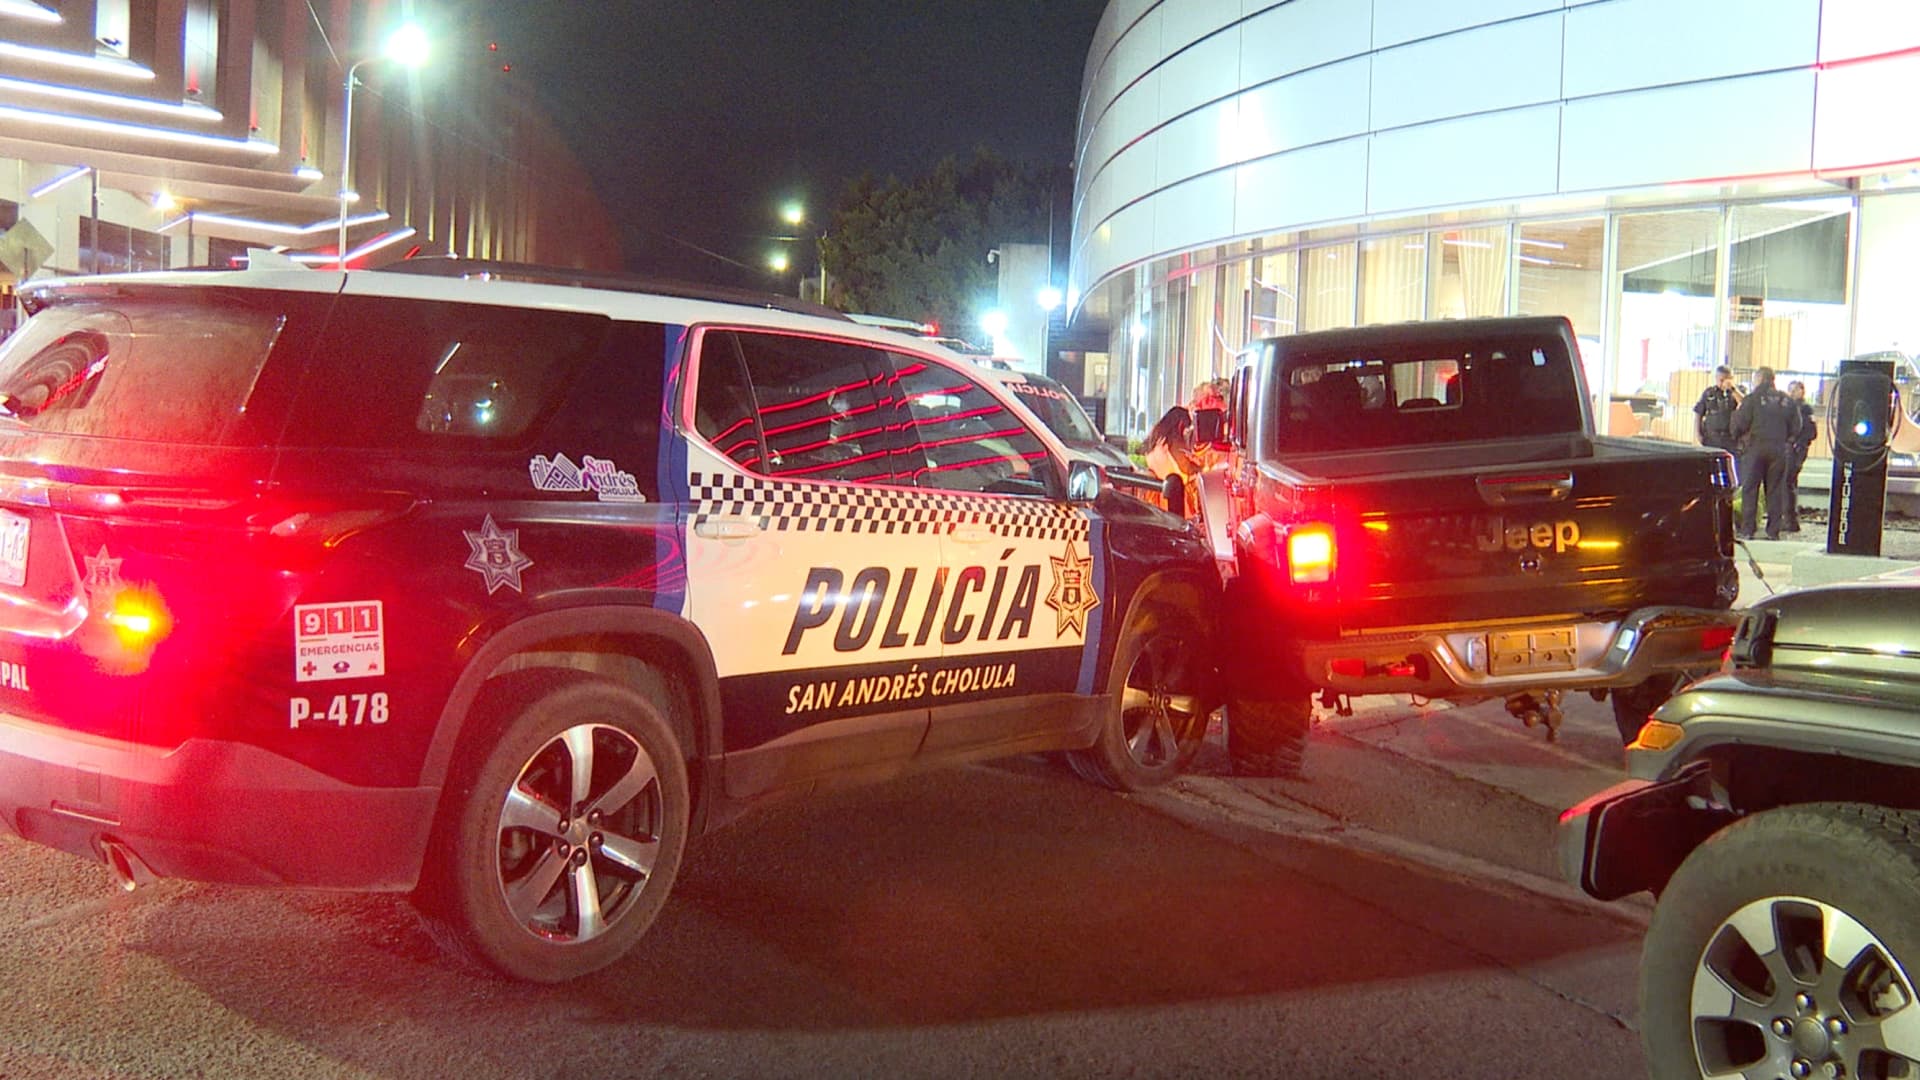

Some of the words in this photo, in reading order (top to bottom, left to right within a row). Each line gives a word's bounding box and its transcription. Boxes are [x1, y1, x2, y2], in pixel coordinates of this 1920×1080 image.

[581, 470, 637, 490] Andrés
[584, 458, 615, 474] San
[600, 486, 640, 496] CHOLULA
[1477, 518, 1580, 553] Jeep
[781, 548, 1041, 656] POLICÍA
[300, 642, 380, 657] EMERGENCIAS
[0, 661, 30, 691] PAL
[785, 681, 837, 715] SAN
[837, 663, 927, 708] ANDRÉS
[930, 663, 1016, 696] CHOLULA
[290, 691, 390, 729] P-478
